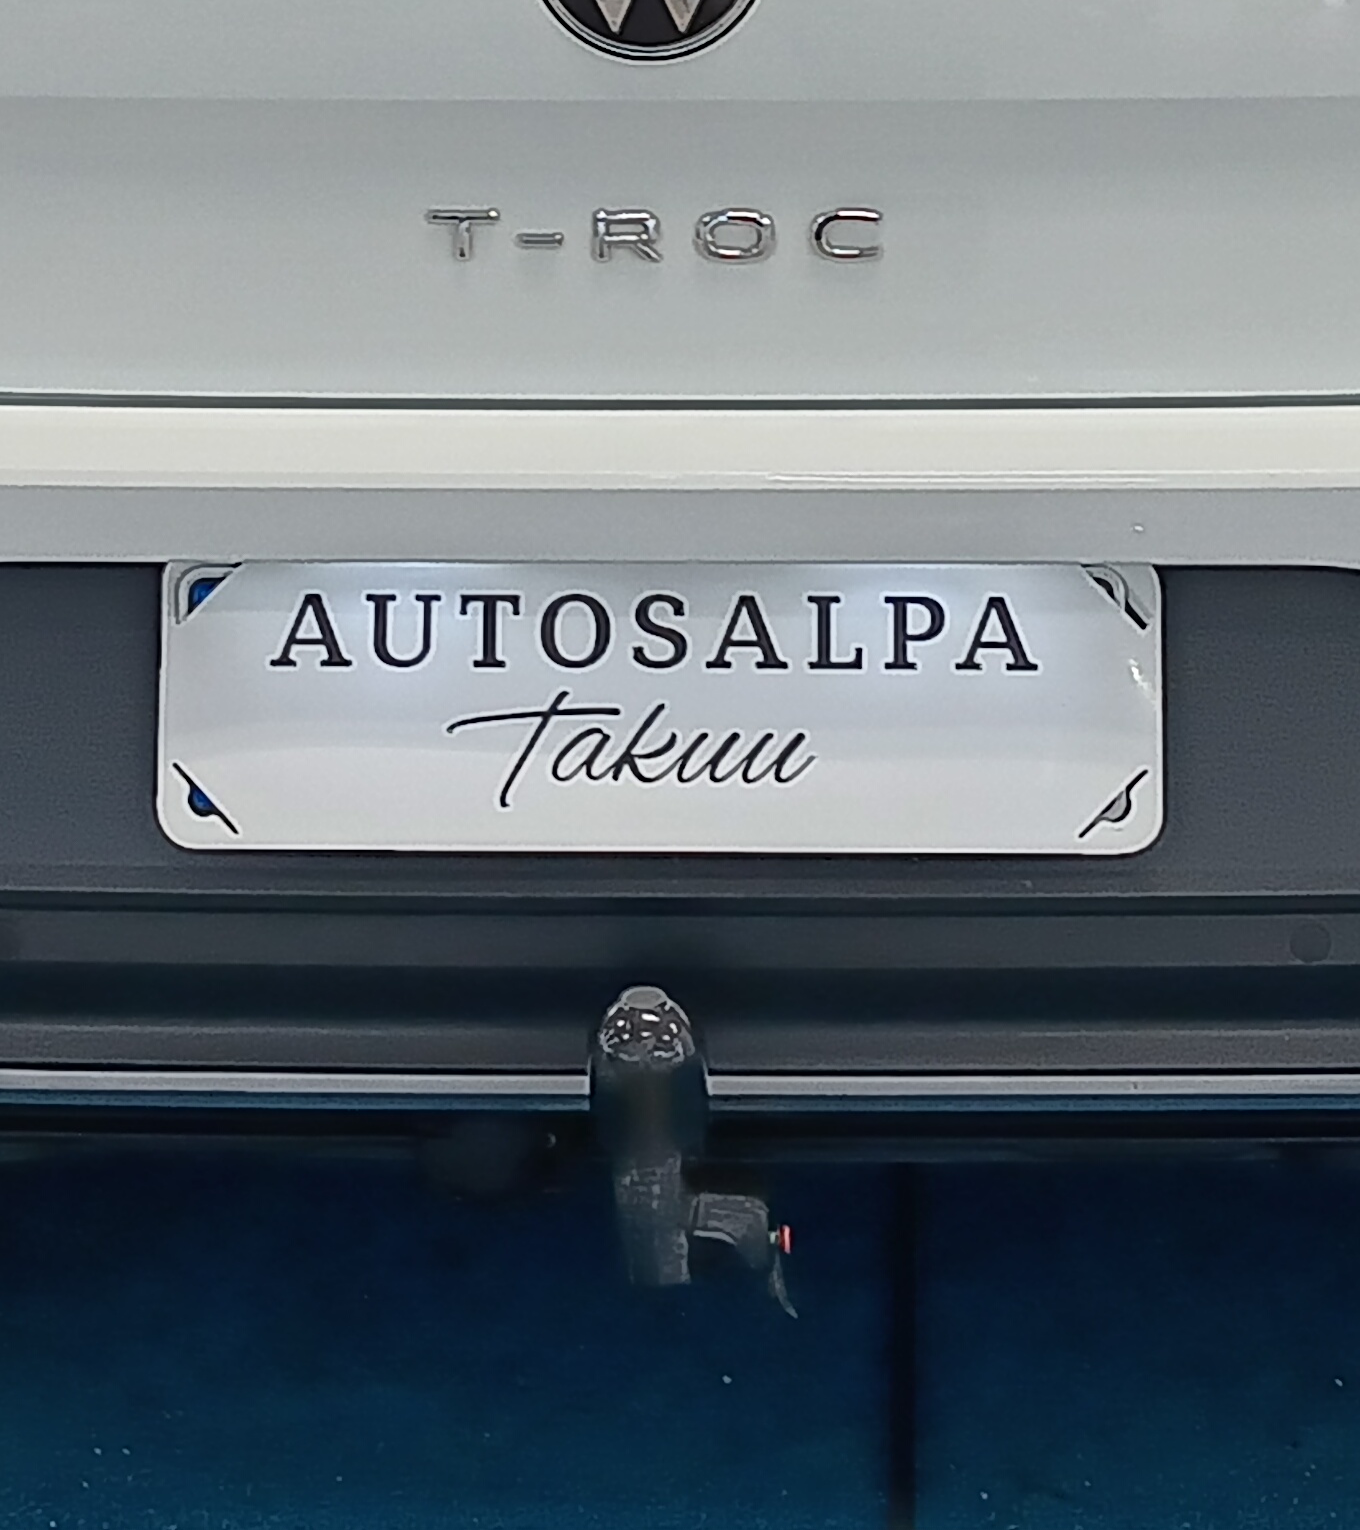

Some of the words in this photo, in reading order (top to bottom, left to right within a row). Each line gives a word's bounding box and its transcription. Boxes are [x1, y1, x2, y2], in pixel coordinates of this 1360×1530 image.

[426, 207, 883, 263] T-ROC
[269, 592, 1038, 671] AUTOSALPA
[445, 691, 817, 809] Takuu
